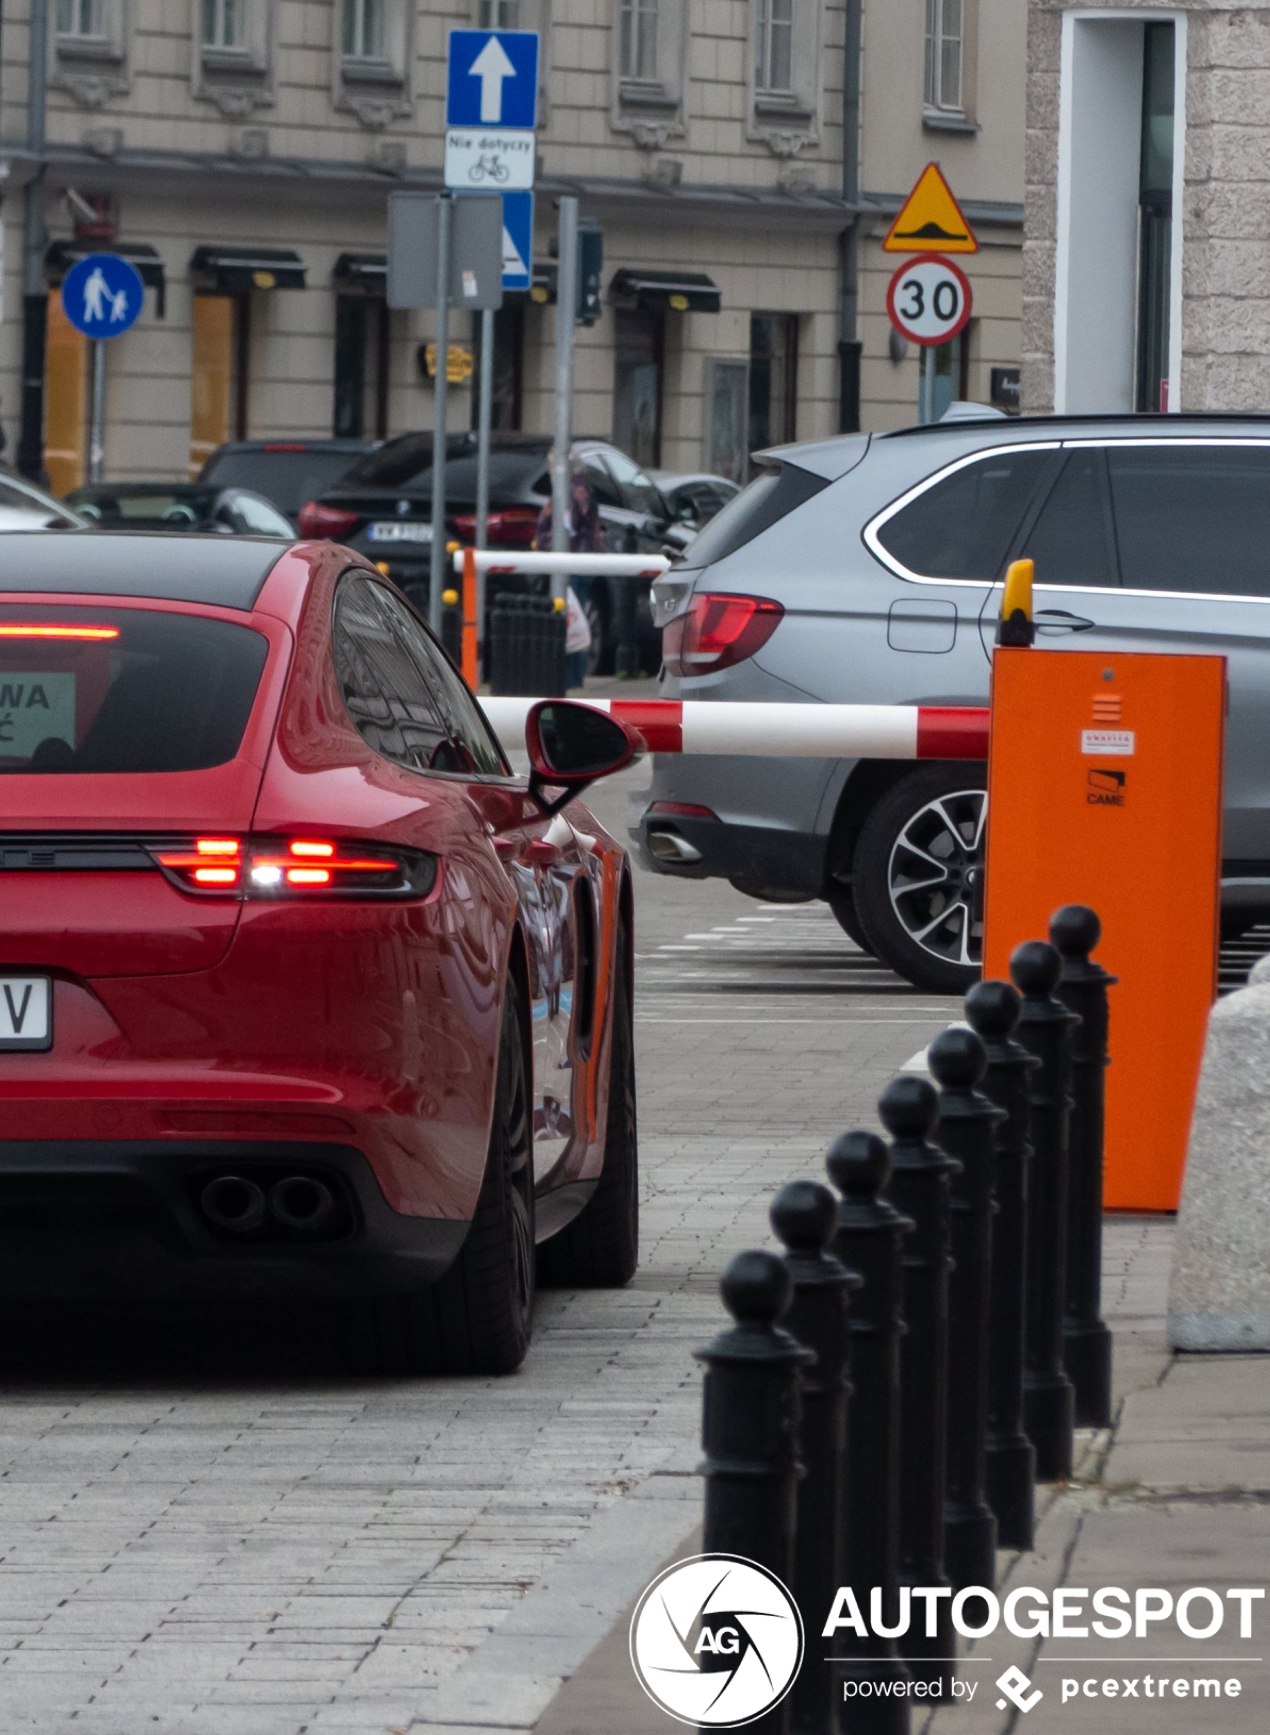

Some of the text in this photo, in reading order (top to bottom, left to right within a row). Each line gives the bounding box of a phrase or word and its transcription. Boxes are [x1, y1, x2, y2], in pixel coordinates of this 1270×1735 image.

[449, 136, 532, 154] Nie dotyczy
[900, 280, 959, 321] 30
[1087, 793, 1125, 807] CAME
